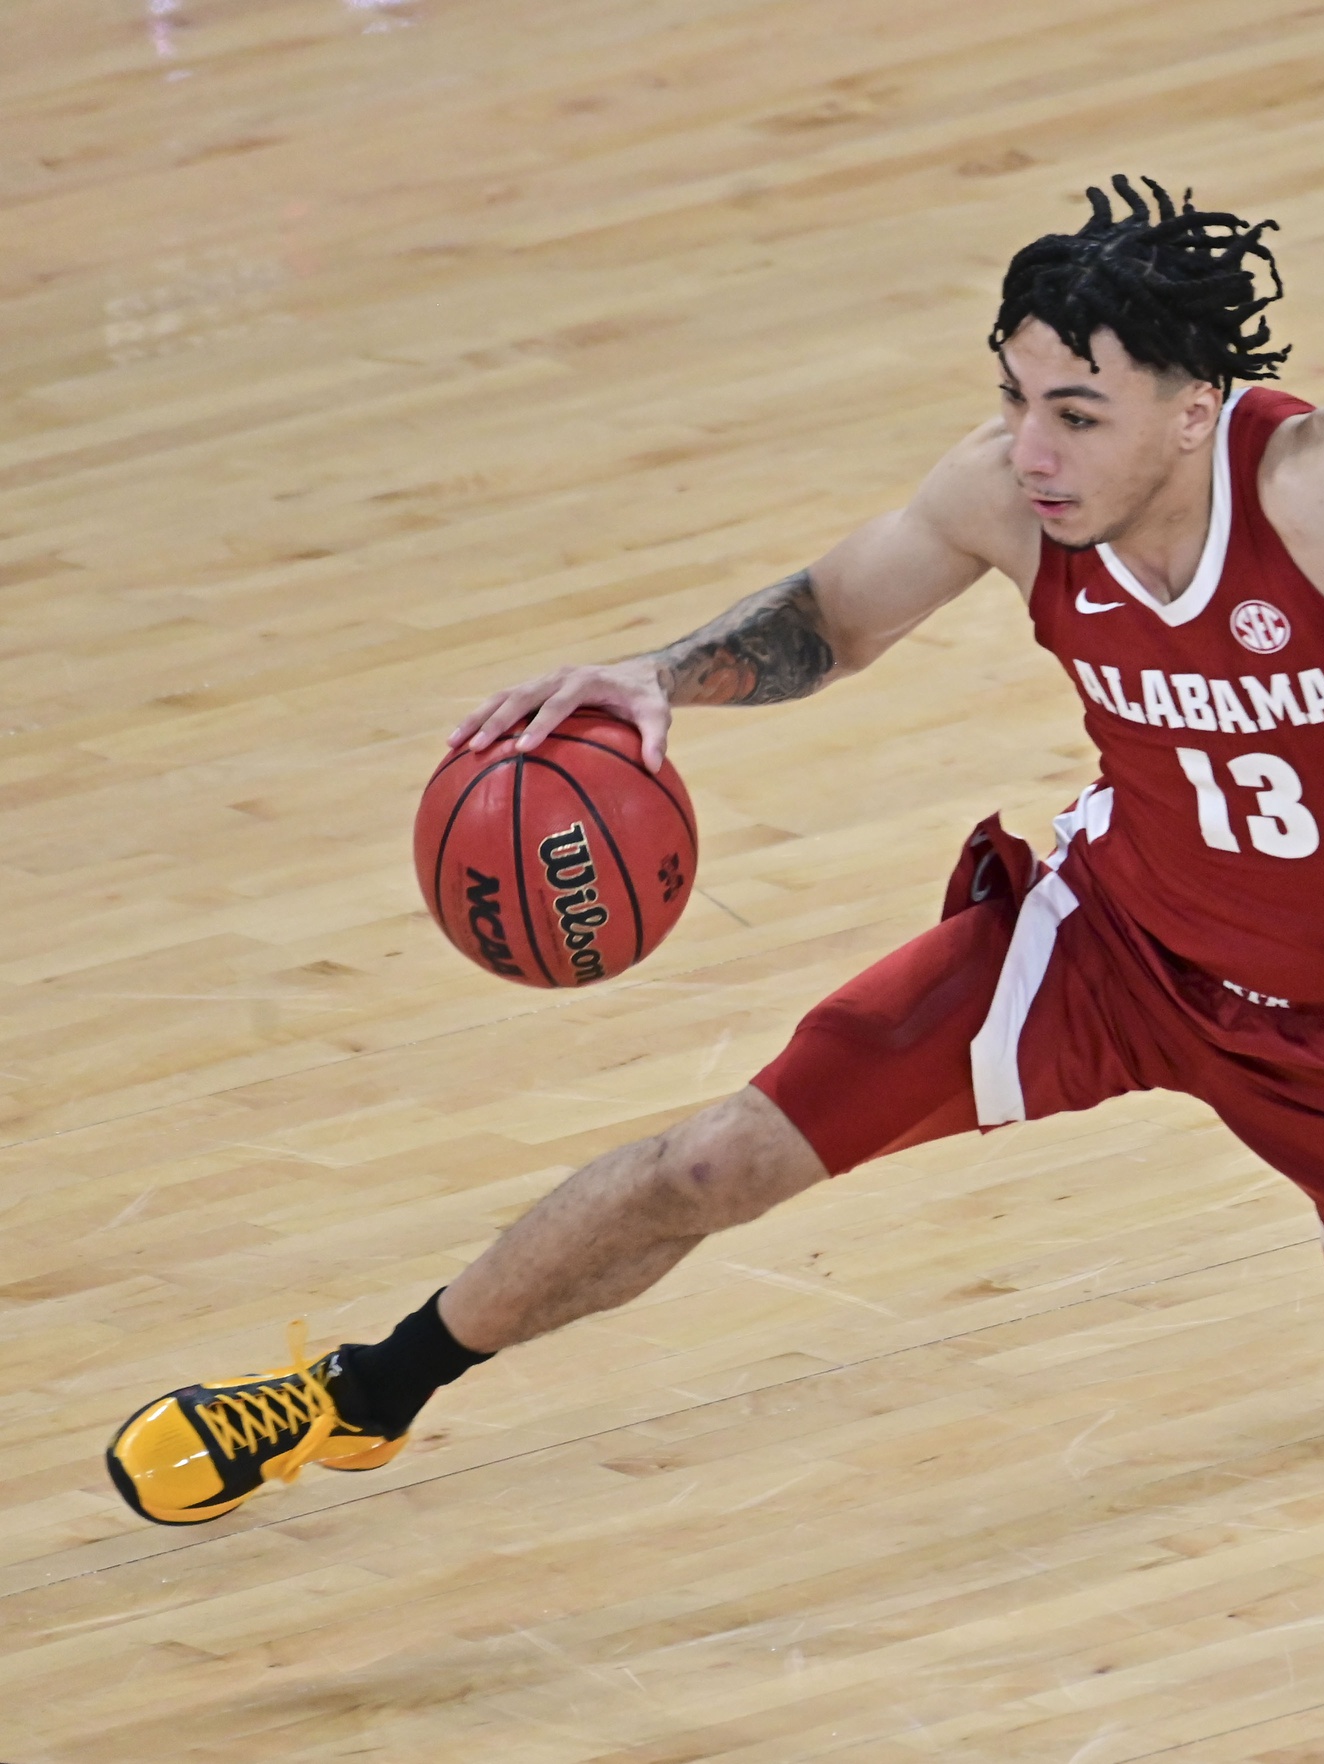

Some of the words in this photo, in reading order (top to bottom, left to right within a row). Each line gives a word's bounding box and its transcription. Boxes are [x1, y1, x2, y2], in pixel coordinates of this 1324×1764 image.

[1233, 603, 1288, 652] SEC
[1175, 747, 1320, 859] 13
[466, 866, 524, 976] NCAA
[538, 821, 608, 984] Wilson
